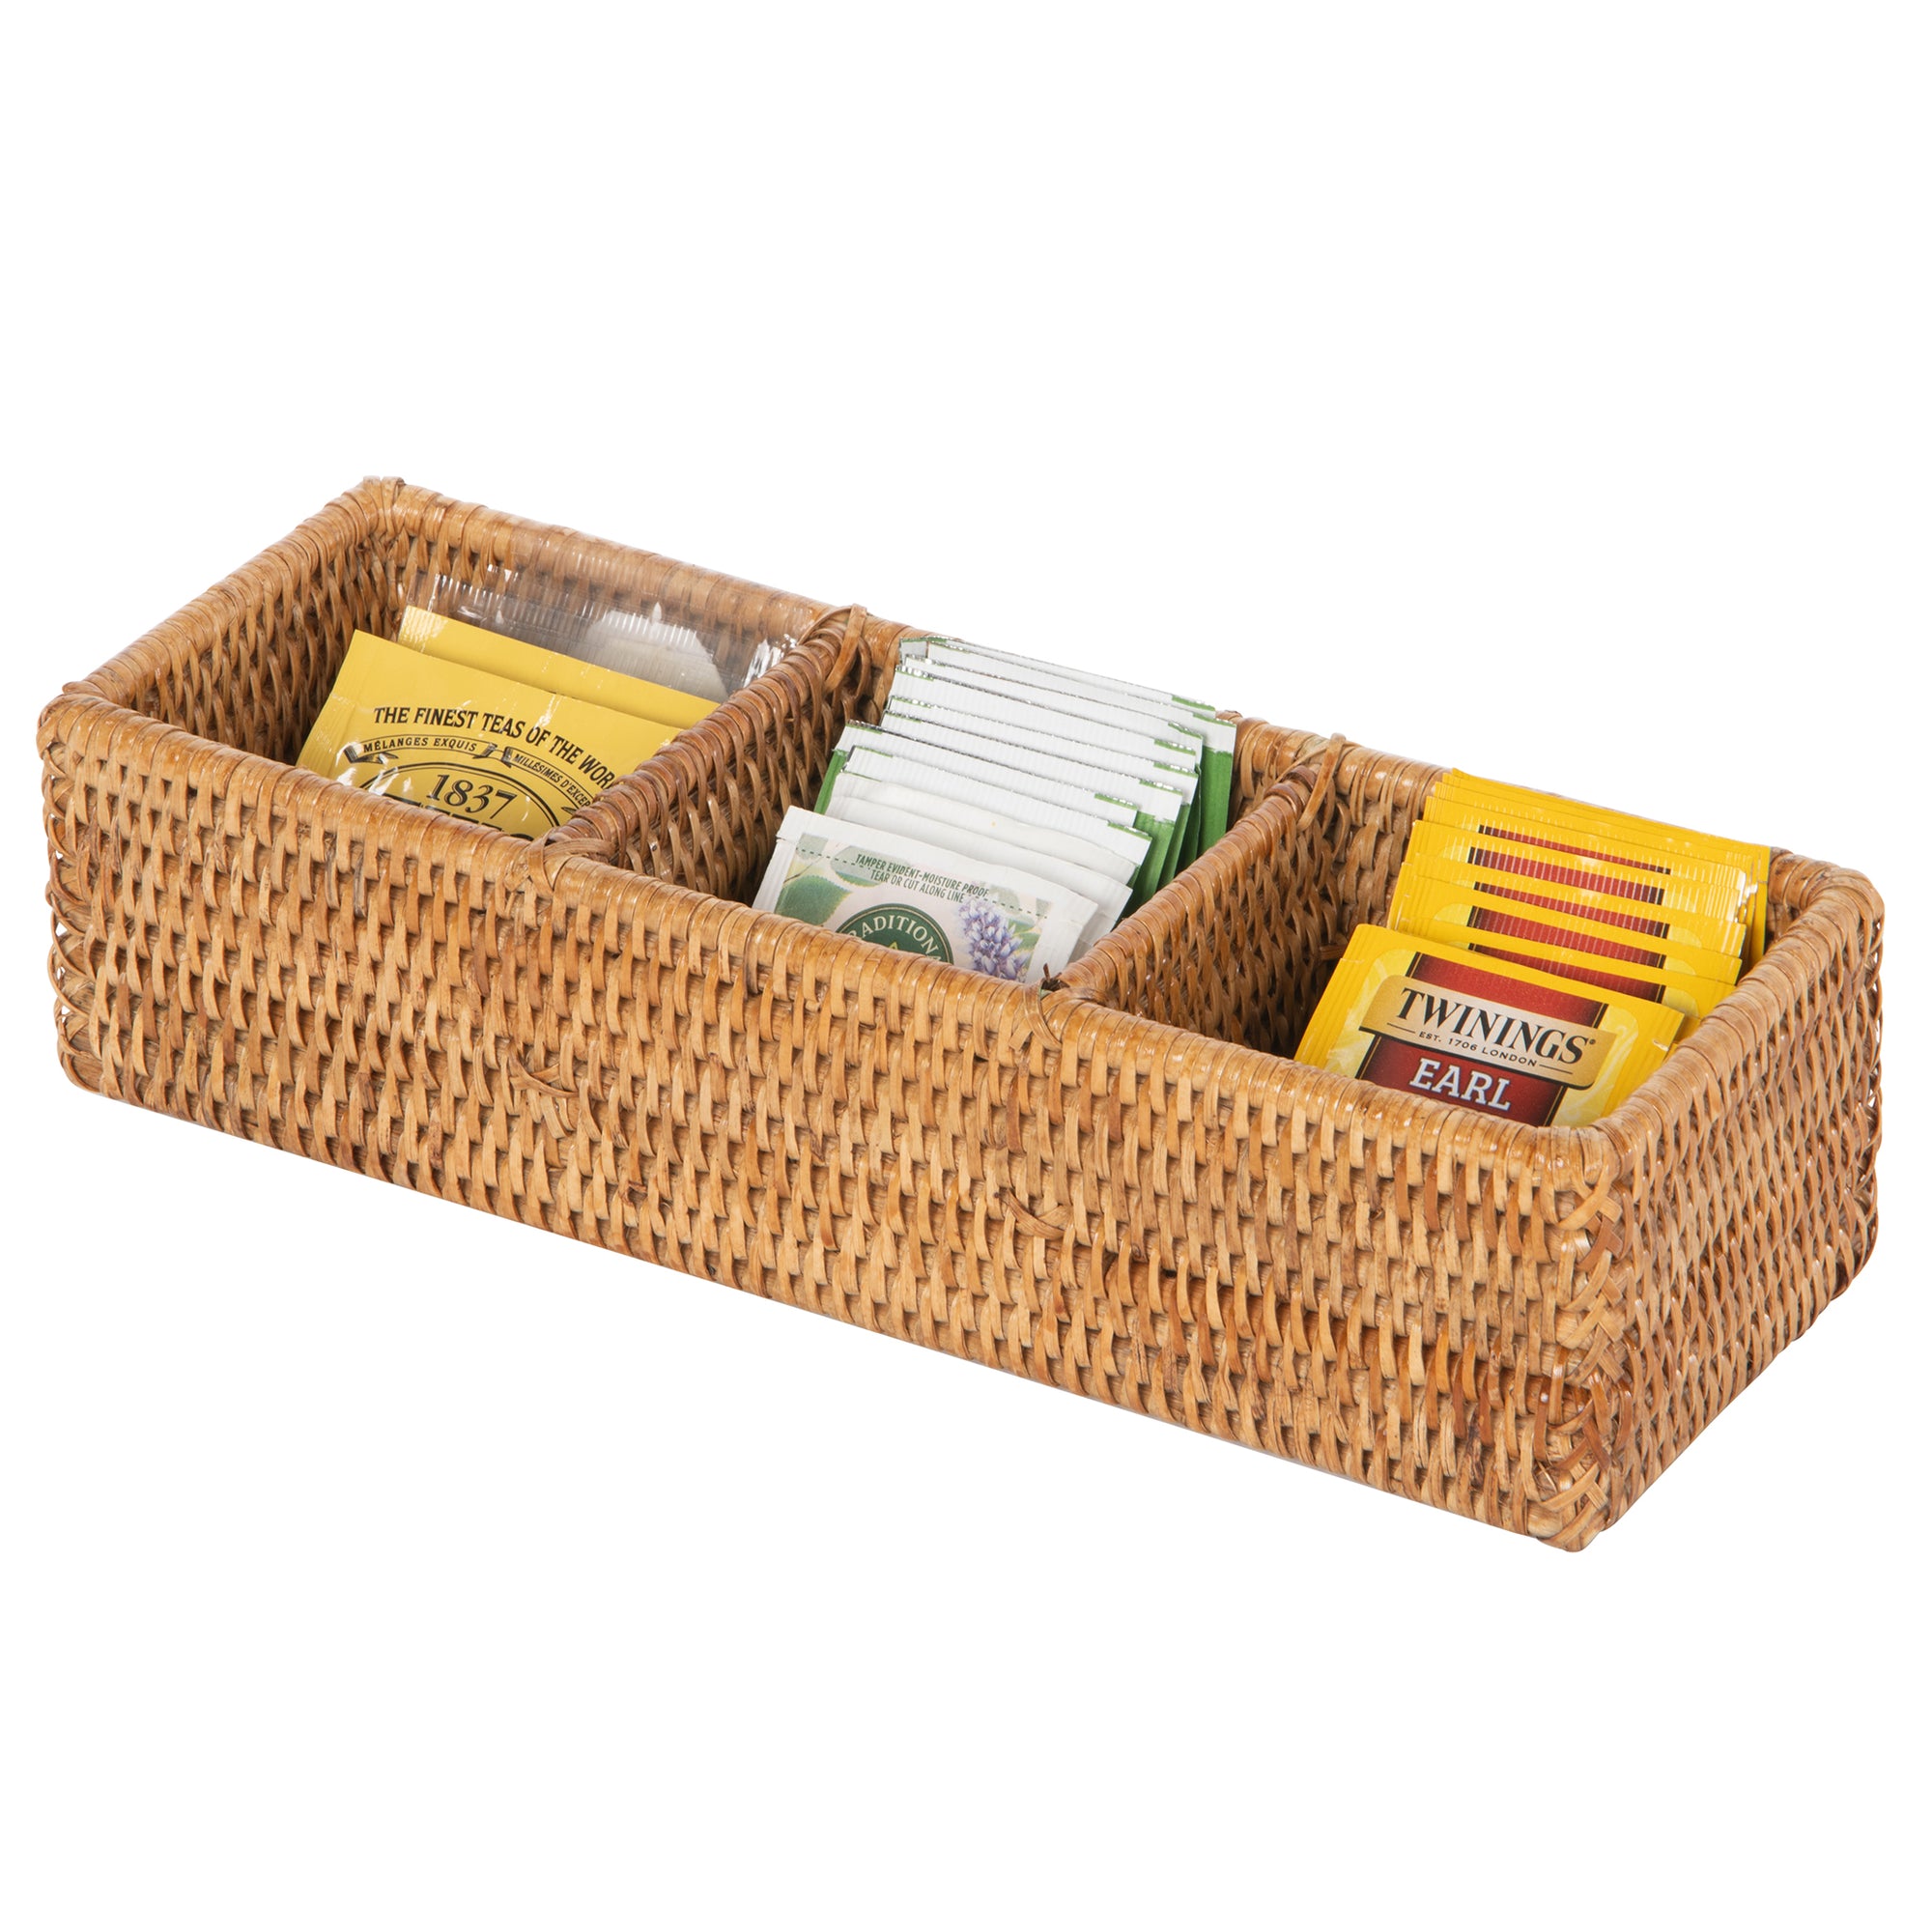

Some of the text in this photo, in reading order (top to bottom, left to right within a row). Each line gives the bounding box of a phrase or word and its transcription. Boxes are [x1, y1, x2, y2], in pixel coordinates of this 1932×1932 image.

[363, 736, 478, 753] MÉLANGES EXQUIS
[374, 706, 411, 724] THE
[413, 707, 478, 729] FINEST
[481, 712, 526, 738] TEAS
[526, 725, 552, 747] OF
[549, 735, 583, 765] THE
[513, 753, 563, 783] MILLÉSIMES
[426, 774, 518, 819] 1837
[855, 853, 990, 897] TAMPER EVIDENT-MOISTURE PROOF
[870, 869, 966, 903] TEAR OR CUT ALONG LINE
[1418, 1031, 1538, 1067] EST. 1706 LONDON
[1408, 1057, 1513, 1112] EARL
